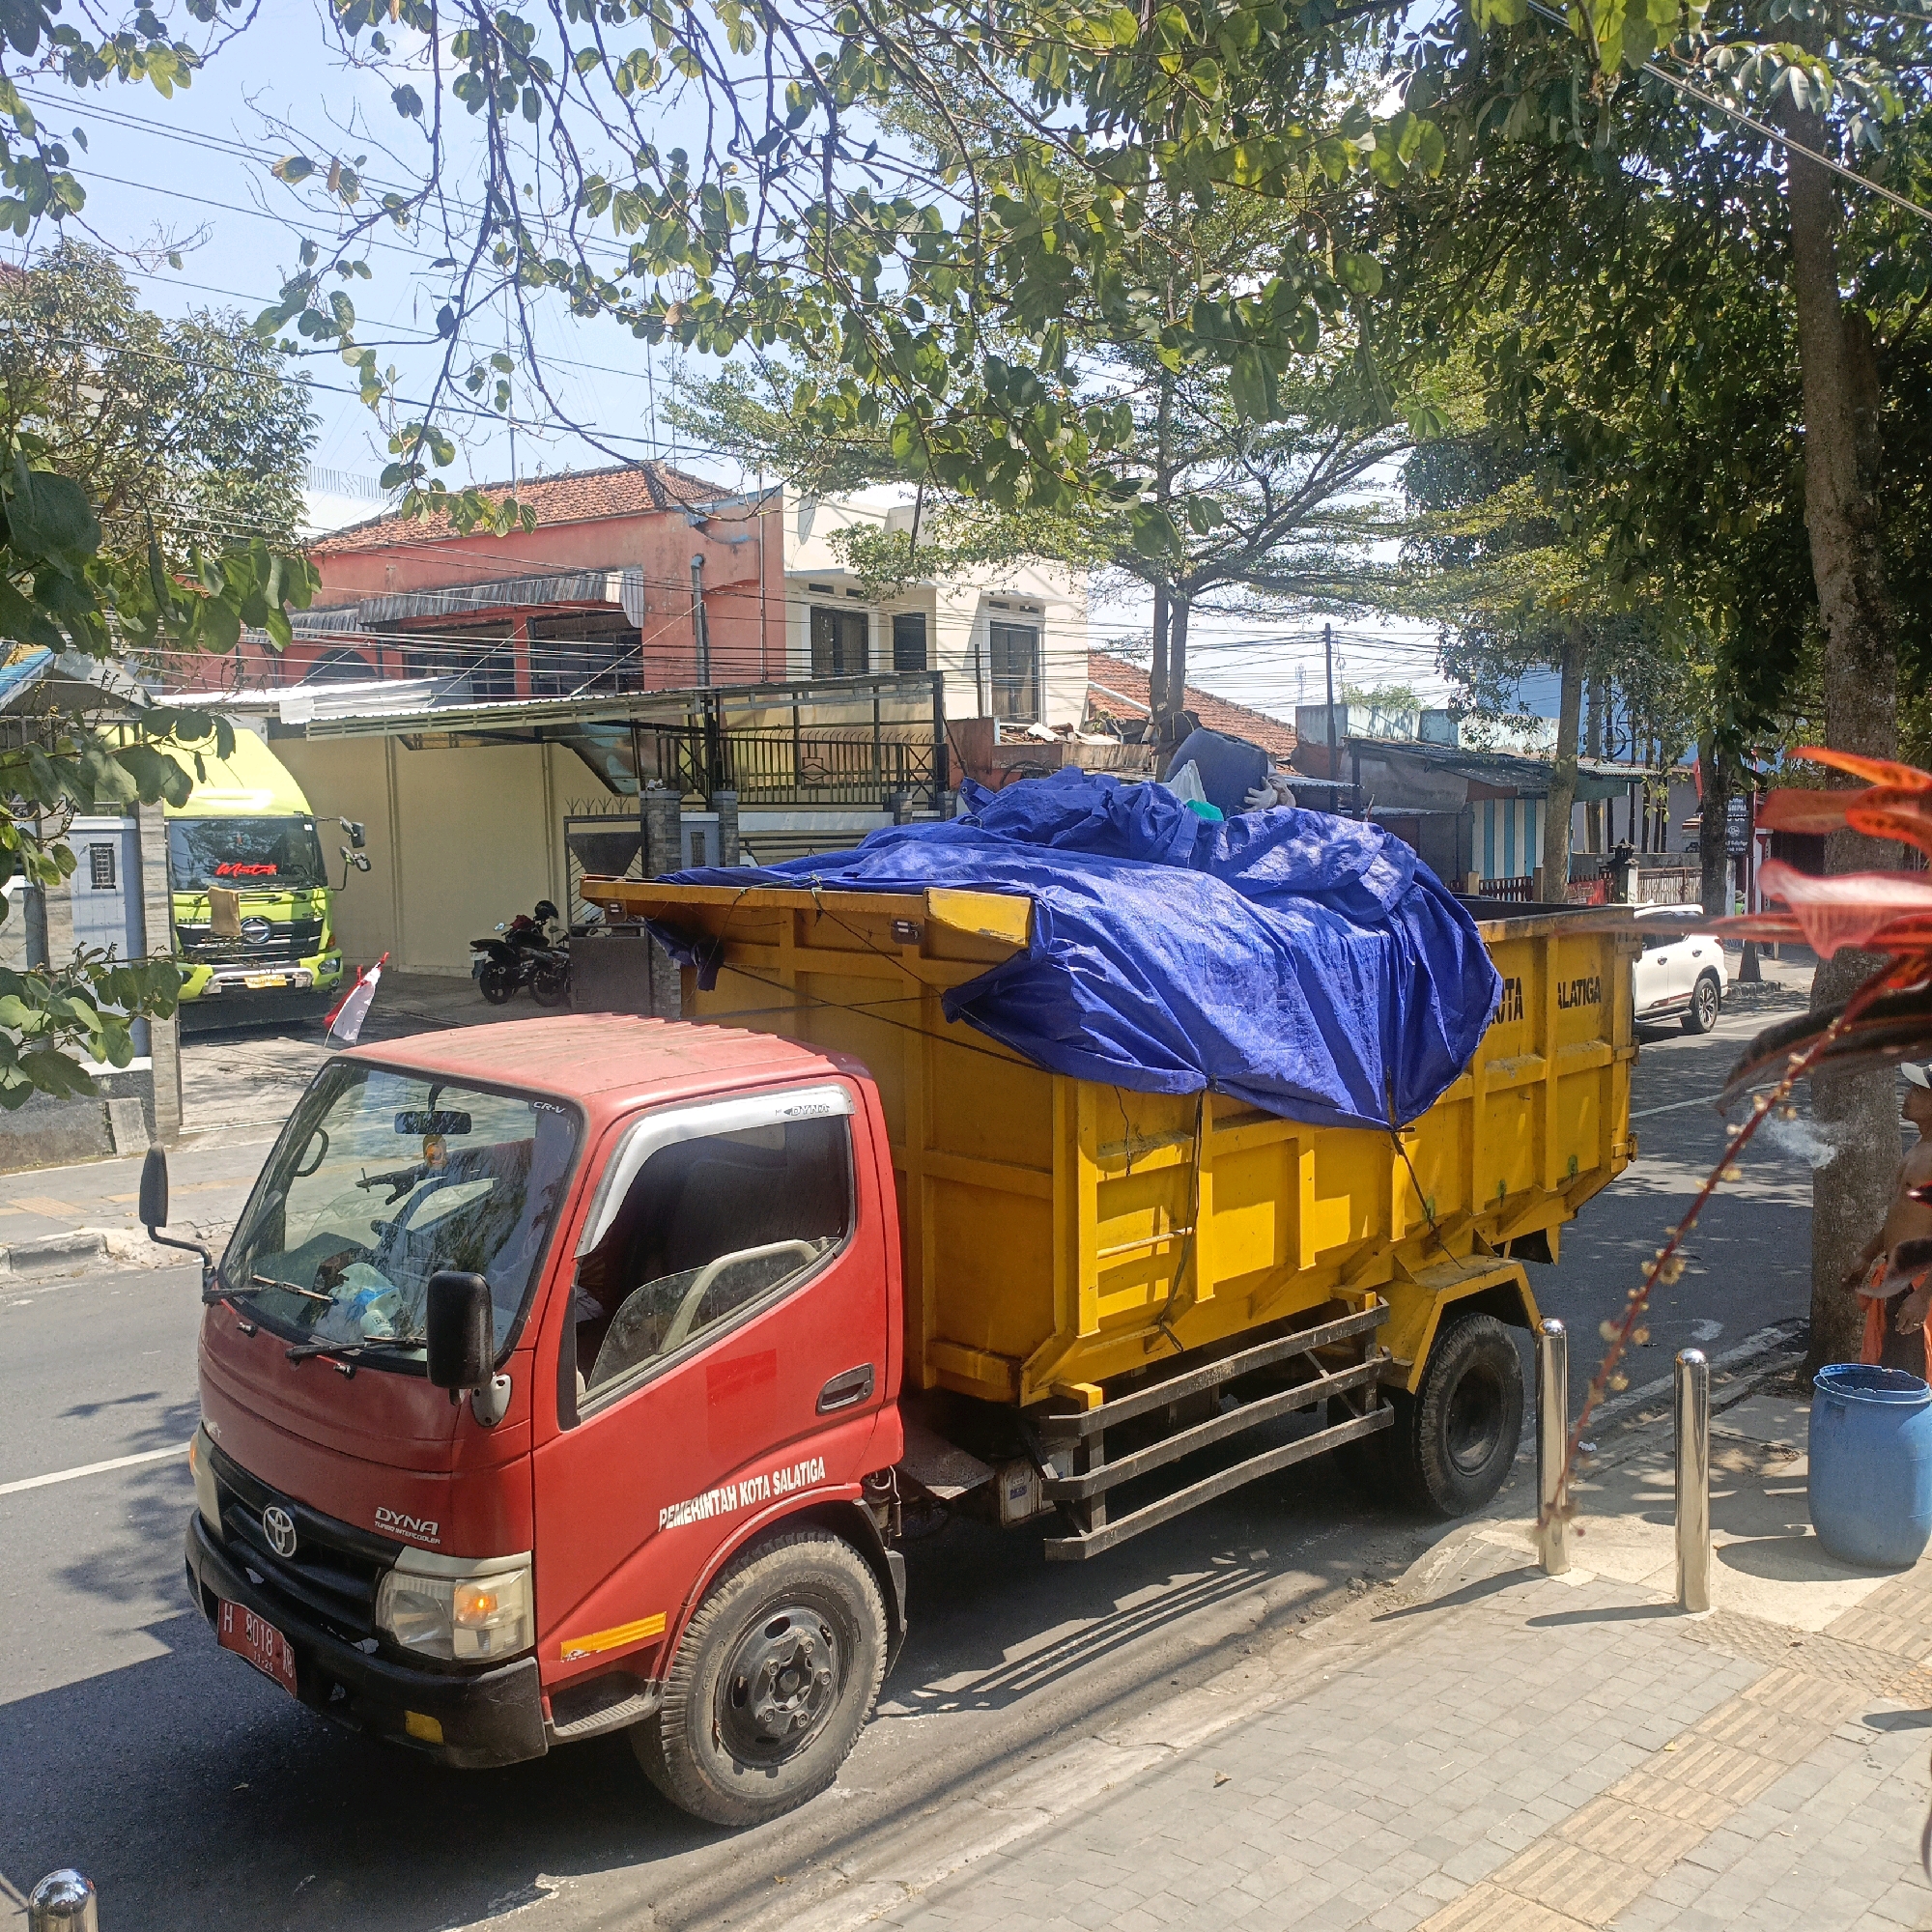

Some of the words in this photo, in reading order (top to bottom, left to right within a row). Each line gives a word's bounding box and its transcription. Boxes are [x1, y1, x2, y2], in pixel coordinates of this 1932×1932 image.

[1492, 977, 1523, 1024] OTA
[533, 1101, 566, 1114] CR-V
[790, 1104, 830, 1116] DYNA
[658, 1485, 737, 1532] PEMERINTAH
[739, 1475, 771, 1507] KOTA
[773, 1457, 825, 1495] SALATIGA
[374, 1520, 395, 1533] TURBO
[395, 1527, 440, 1545] INTERCOOLER
[375, 1507, 438, 1535] DYNA
[224, 1603, 233, 1633] H
[246, 1613, 272, 1657] 8018
